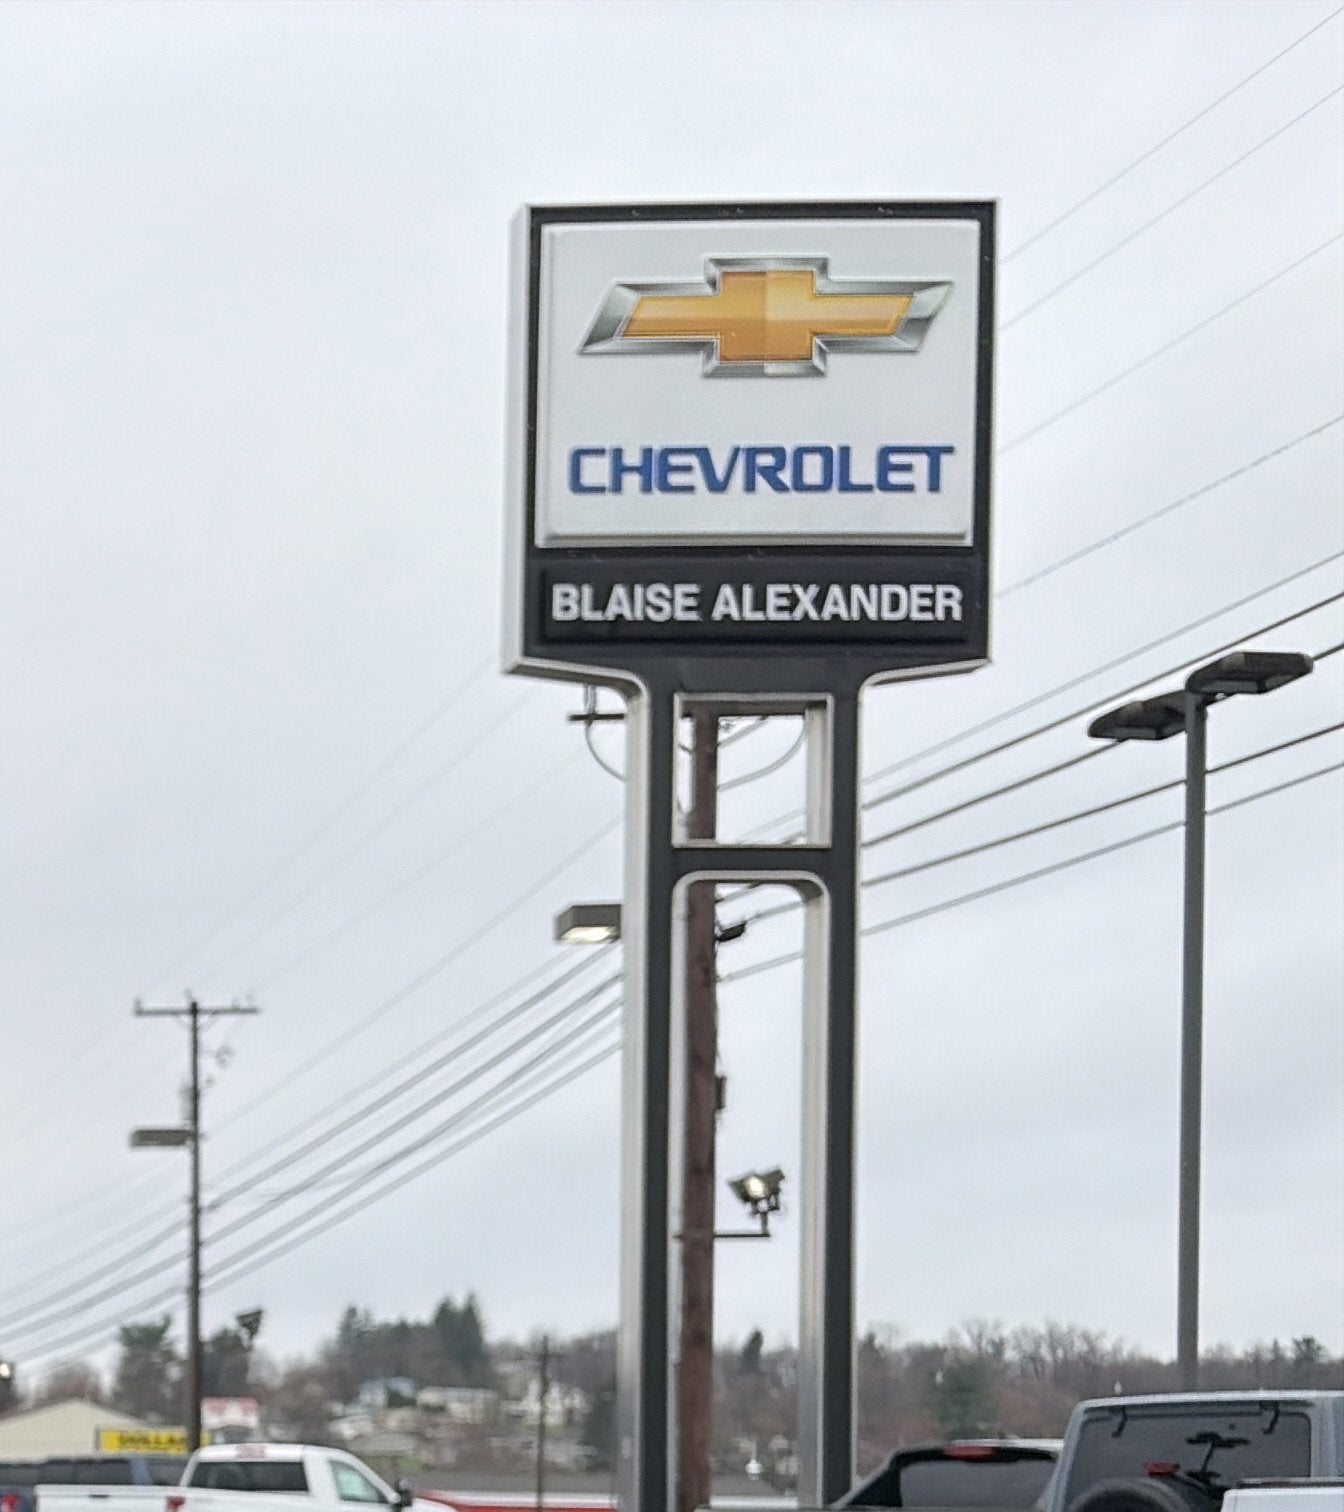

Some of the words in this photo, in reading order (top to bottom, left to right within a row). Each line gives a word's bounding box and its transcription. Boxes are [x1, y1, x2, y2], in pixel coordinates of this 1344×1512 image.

[569, 445, 955, 494] CHEVROLET
[551, 583, 702, 622] BLAISE
[711, 583, 964, 622] ALEXANDER
